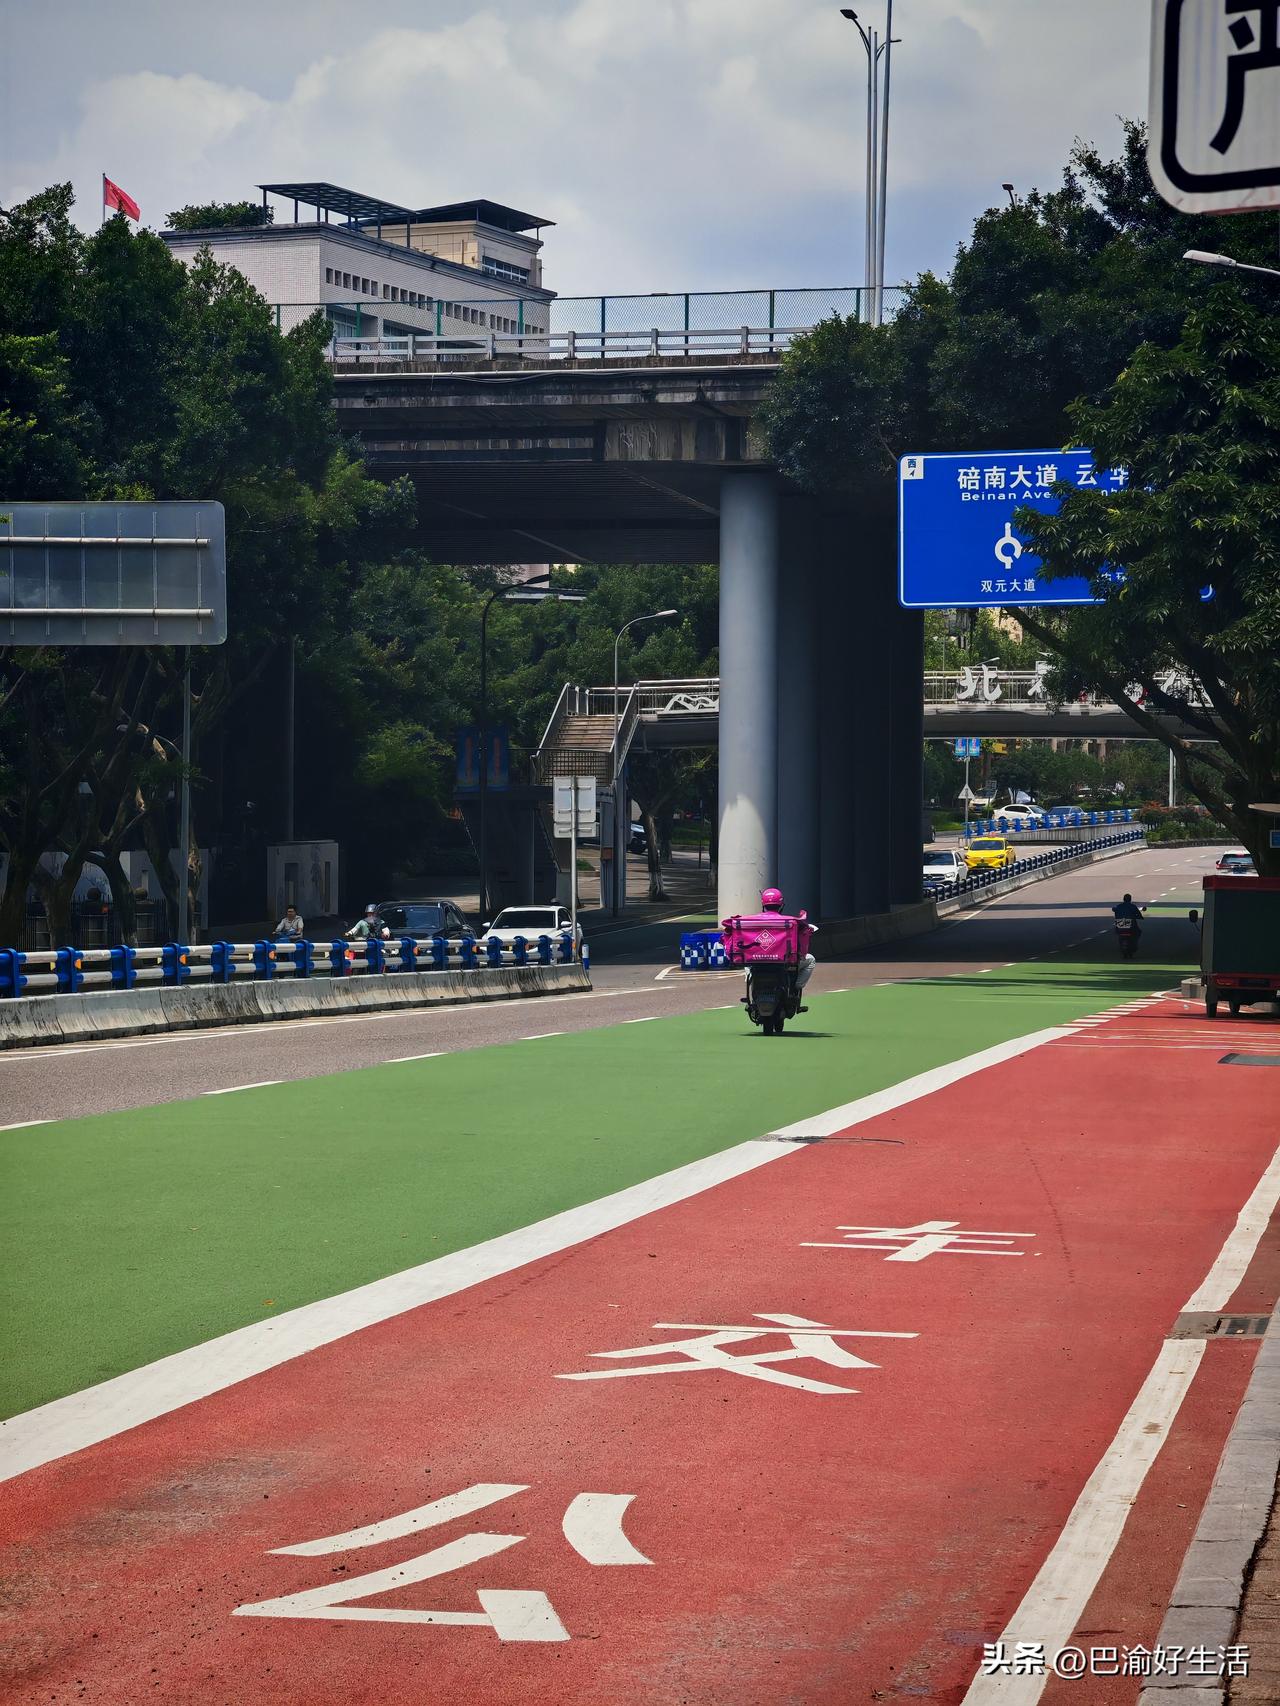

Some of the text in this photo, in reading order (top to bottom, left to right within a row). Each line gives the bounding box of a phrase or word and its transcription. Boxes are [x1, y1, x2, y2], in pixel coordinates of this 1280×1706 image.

[907, 458, 917, 469] 西
[957, 464, 1058, 491] 碚南大道
[961, 491, 1017, 501] Beinan
[980, 578, 1036, 593] 双元大道
